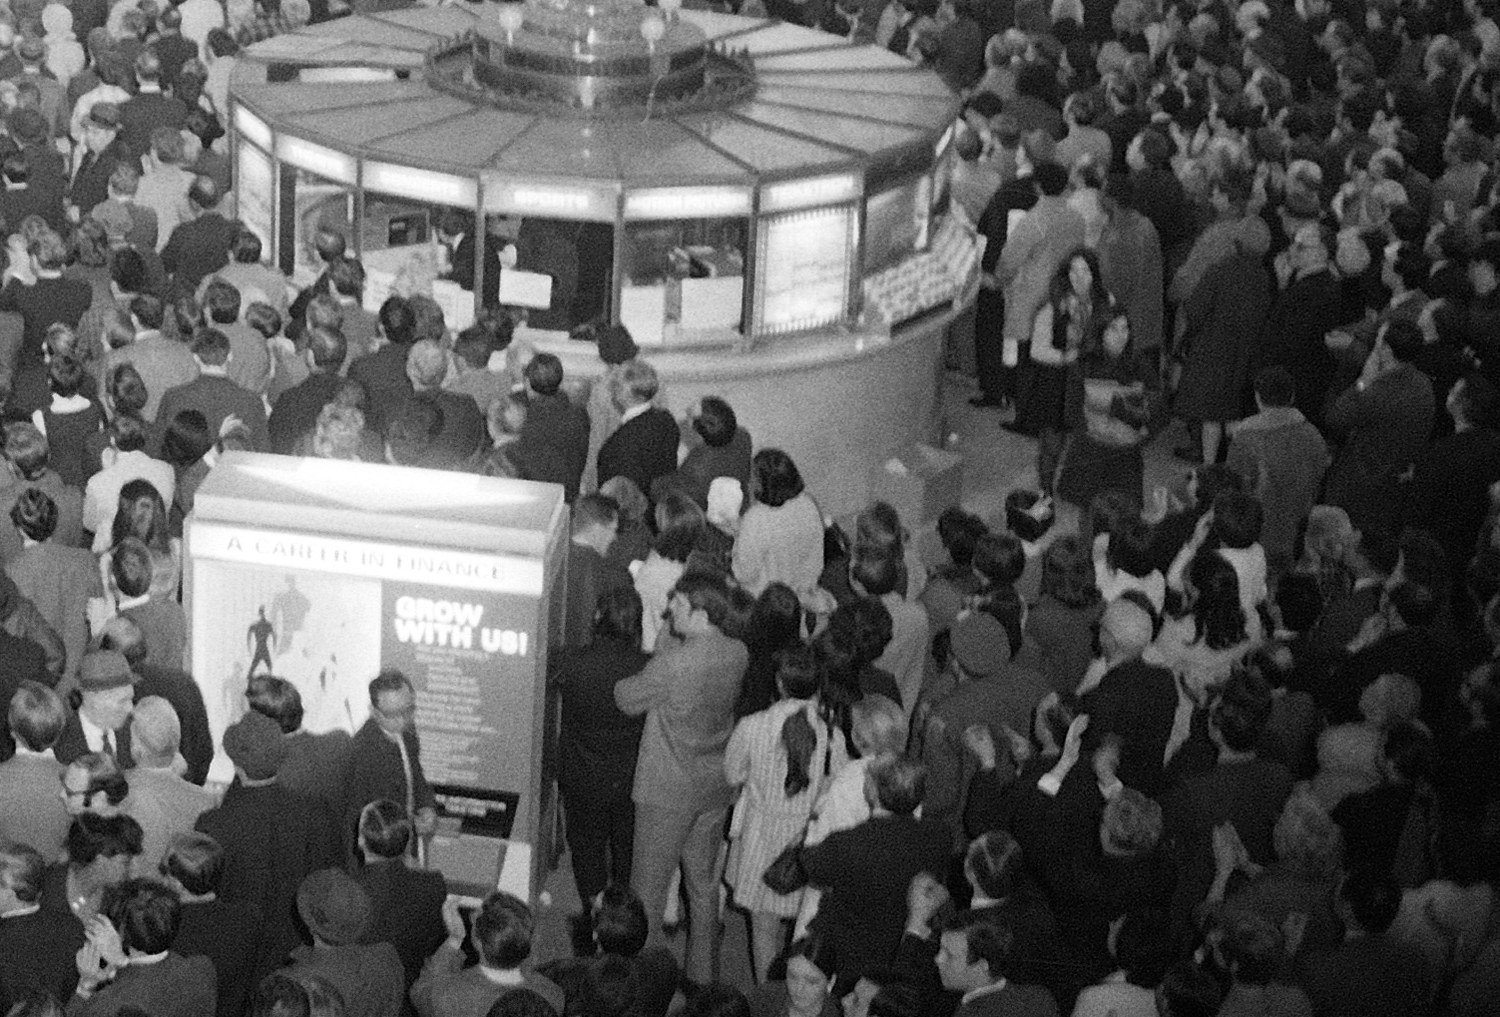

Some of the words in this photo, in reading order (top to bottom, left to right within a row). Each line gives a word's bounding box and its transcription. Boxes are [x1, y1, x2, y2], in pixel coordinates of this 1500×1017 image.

[227, 537, 242, 552] A
[255, 537, 348, 564] CAREER
[361, 551, 384, 568] IN
[396, 556, 504, 581] FINANCE
[396, 596, 483, 628] GROW
[394, 618, 472, 649] WITH
[481, 627, 527, 657] US!
